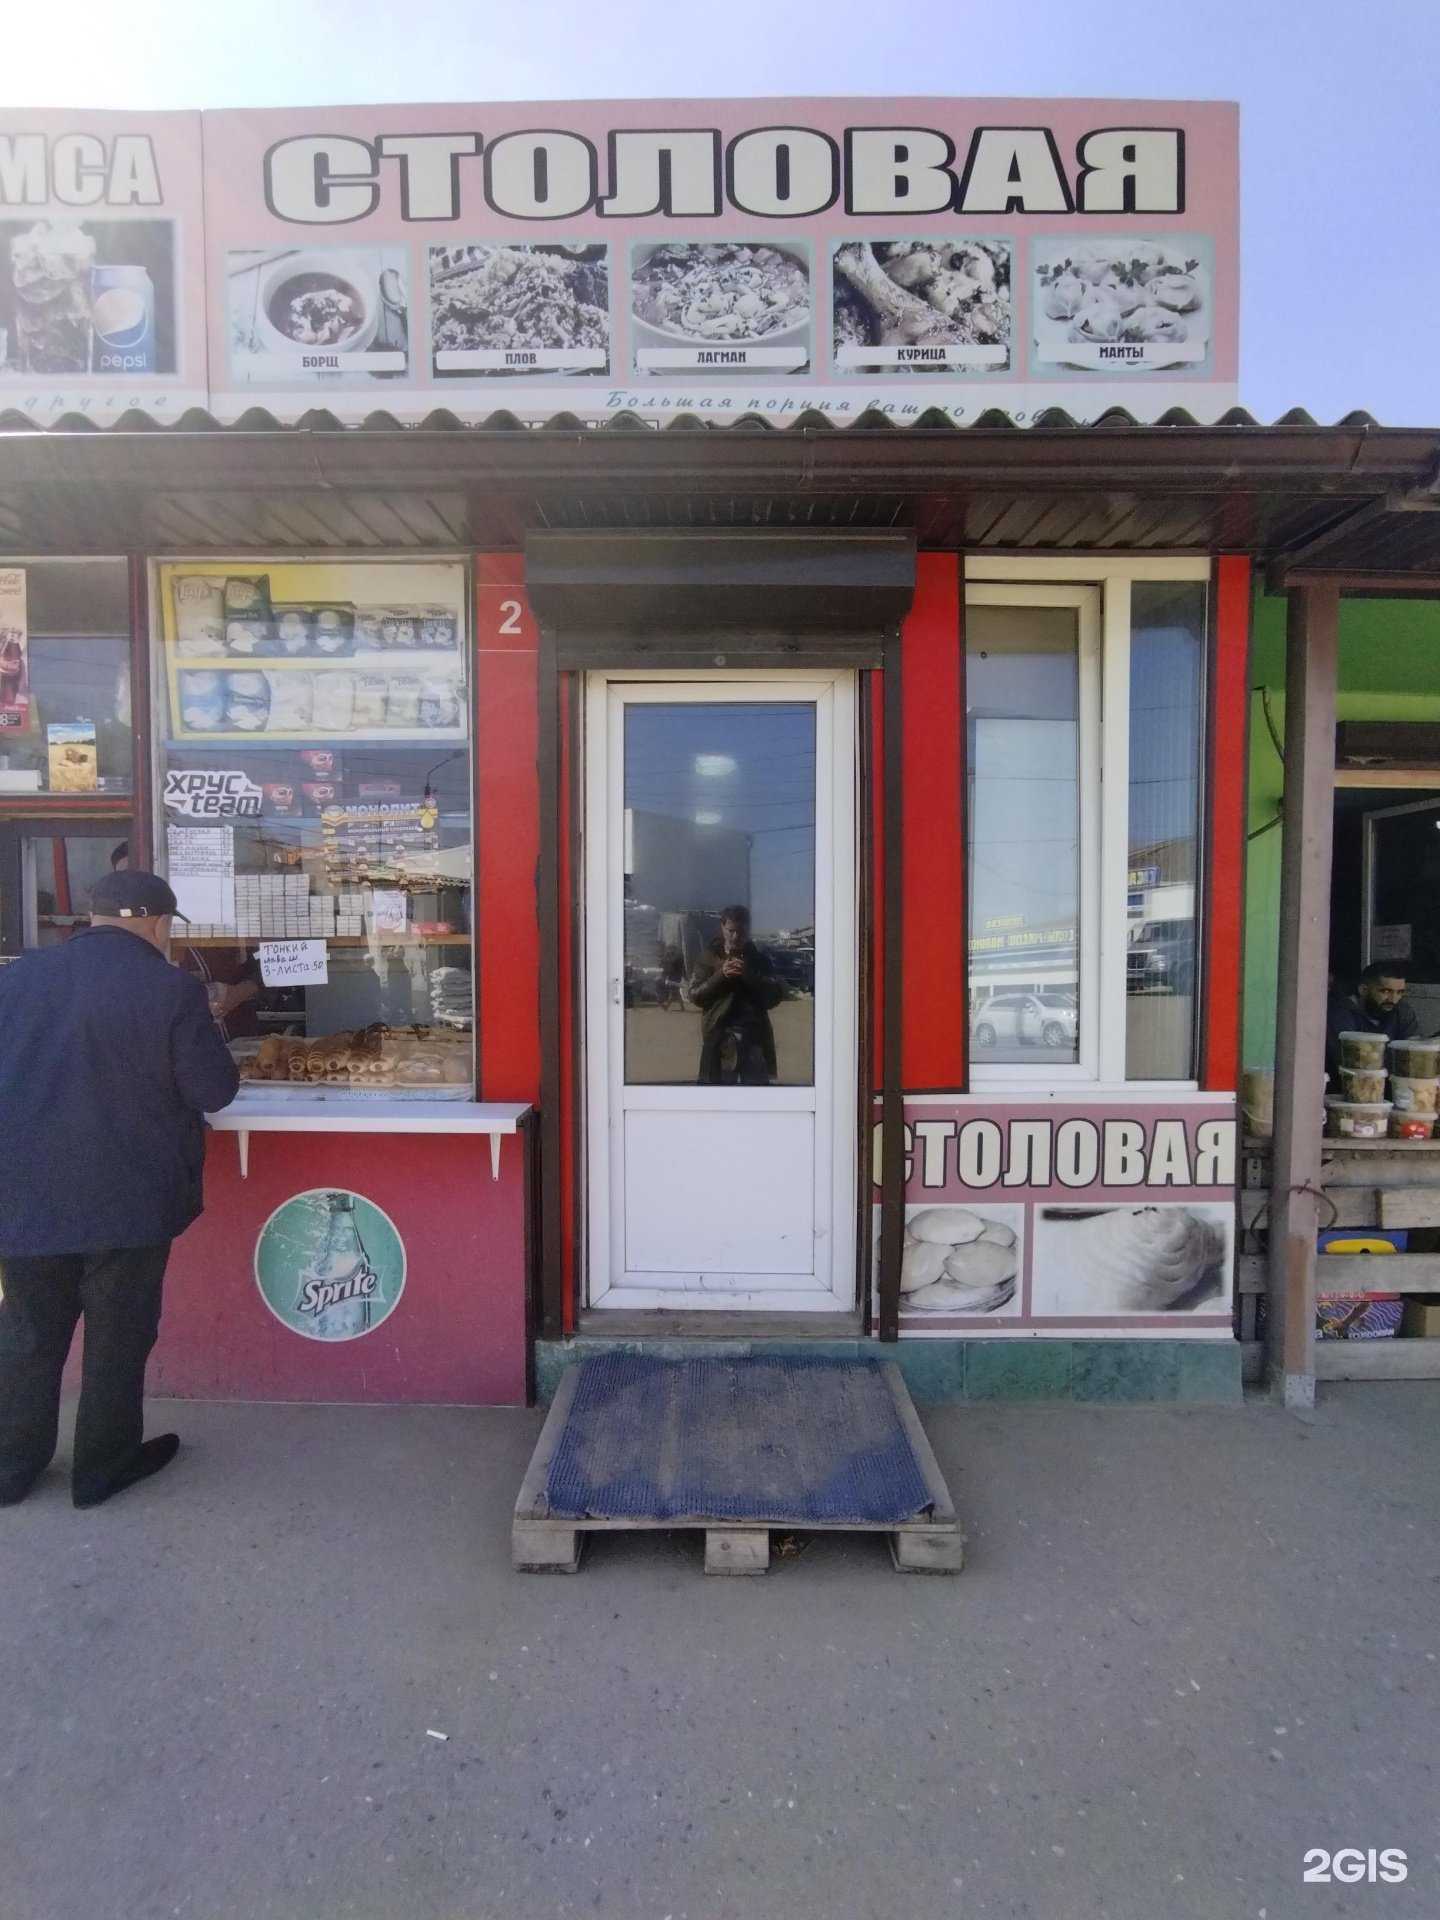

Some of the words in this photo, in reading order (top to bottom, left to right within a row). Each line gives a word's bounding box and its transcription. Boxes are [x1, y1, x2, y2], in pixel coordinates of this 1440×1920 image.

[263, 126, 1186, 226] СТОЛОВАЯ
[100, 352, 147, 369] pepsi
[505, 353, 537, 365] ПЛОВ
[697, 351, 747, 364] ЛАГМАН
[897, 348, 946, 361] КУРИЦА
[1099, 346, 1144, 359] МАНТЫ
[302, 356, 340, 369] БОРЩ
[606, 390, 732, 408] Большая
[498, 600, 522, 634] 2
[191, 793, 262, 816] team
[297, 1267, 377, 1317] Sprite
